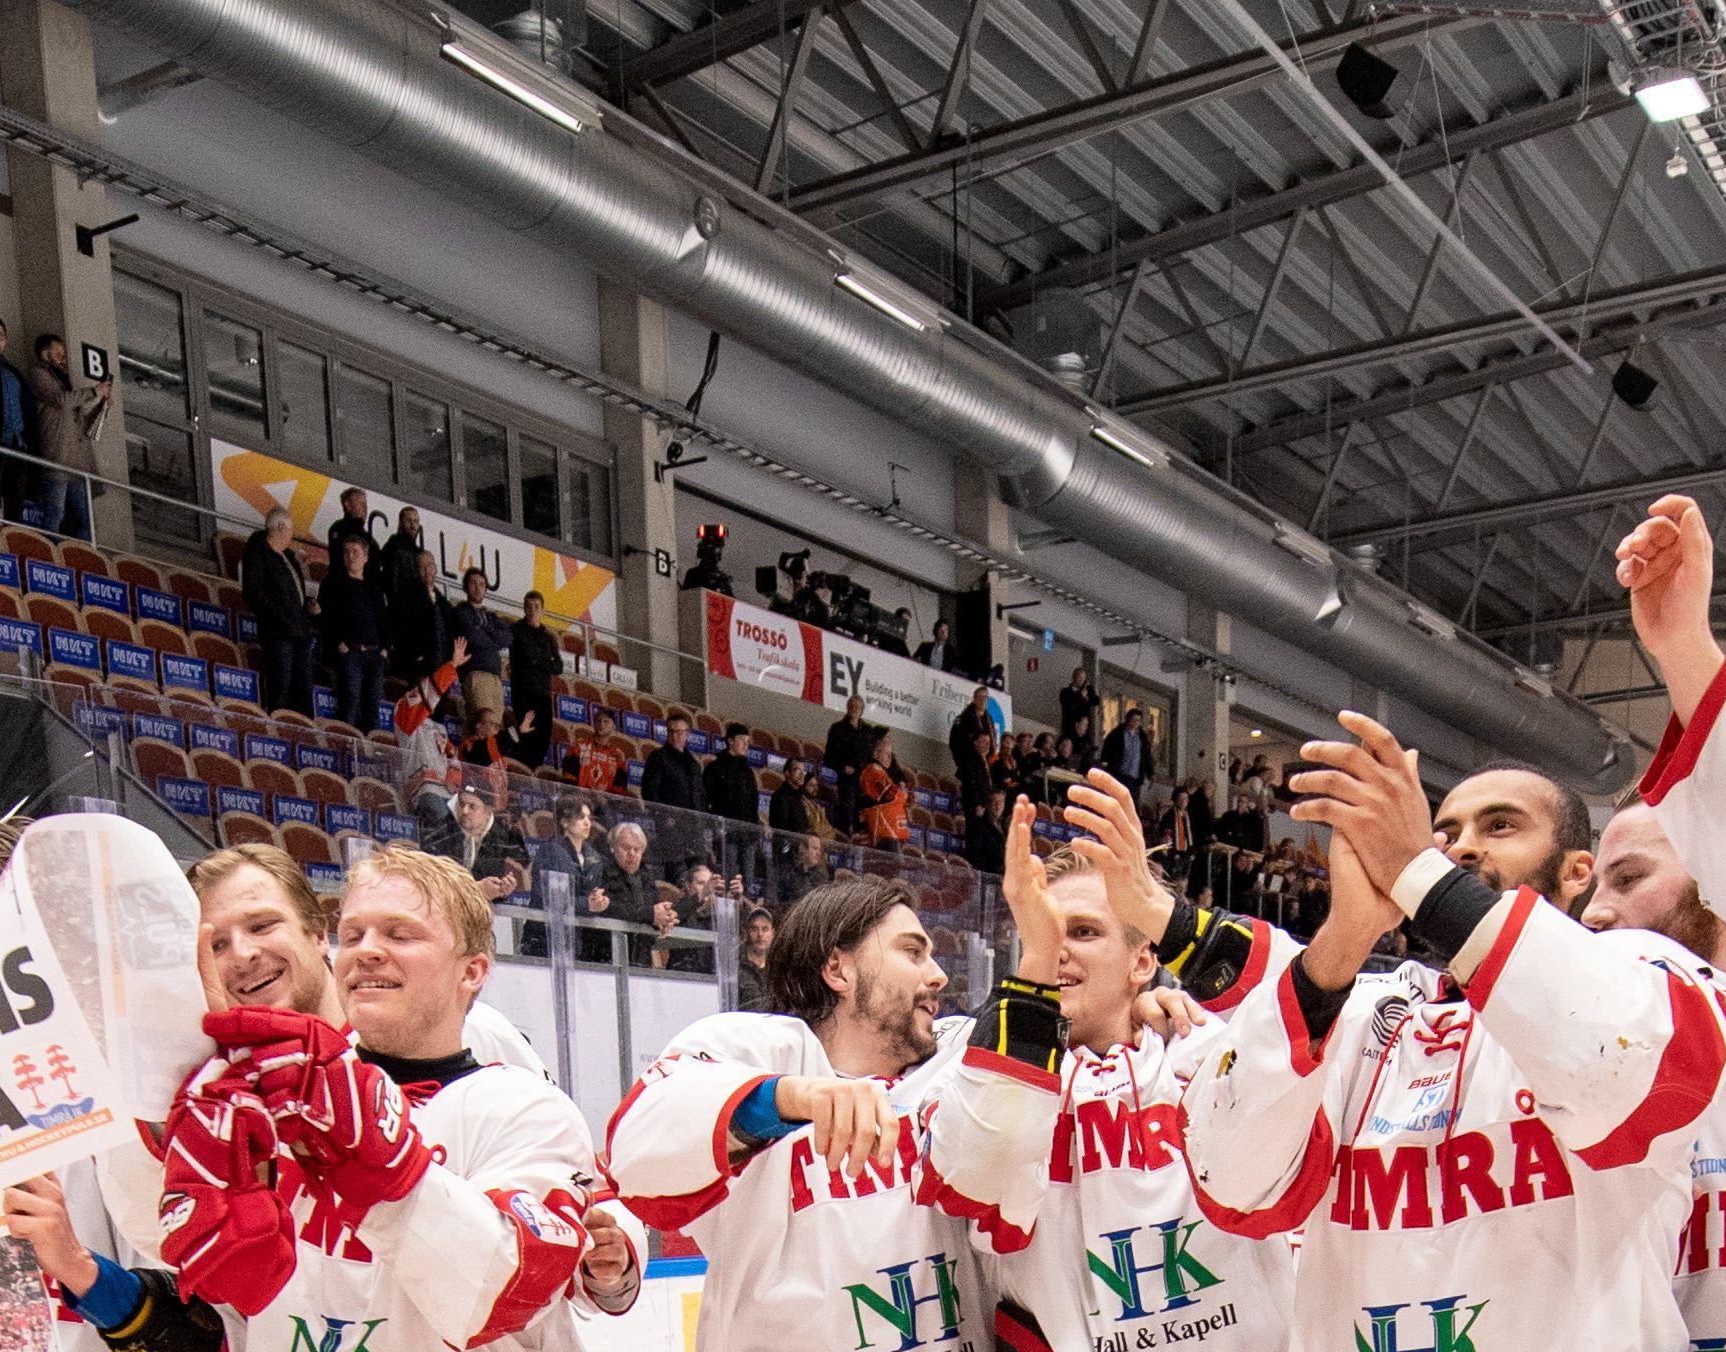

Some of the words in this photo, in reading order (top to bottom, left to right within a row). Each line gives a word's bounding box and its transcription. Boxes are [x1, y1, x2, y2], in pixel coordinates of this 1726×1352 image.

[85, 349, 103, 378] B
[656, 553, 670, 574] B
[33, 567, 70, 587] NKT
[87, 581, 123, 601] NKT
[142, 595, 176, 614] NKT
[735, 618, 788, 650] TROSSÖ
[55, 636, 94, 657] NKT
[112, 649, 150, 669] NKT
[167, 660, 203, 679] NKT
[829, 650, 865, 697] EY
[219, 673, 253, 690] NKT
[140, 719, 178, 737] NKT
[1137, 1327, 1156, 1351] &
[1161, 1303, 1238, 1347] Kapell
